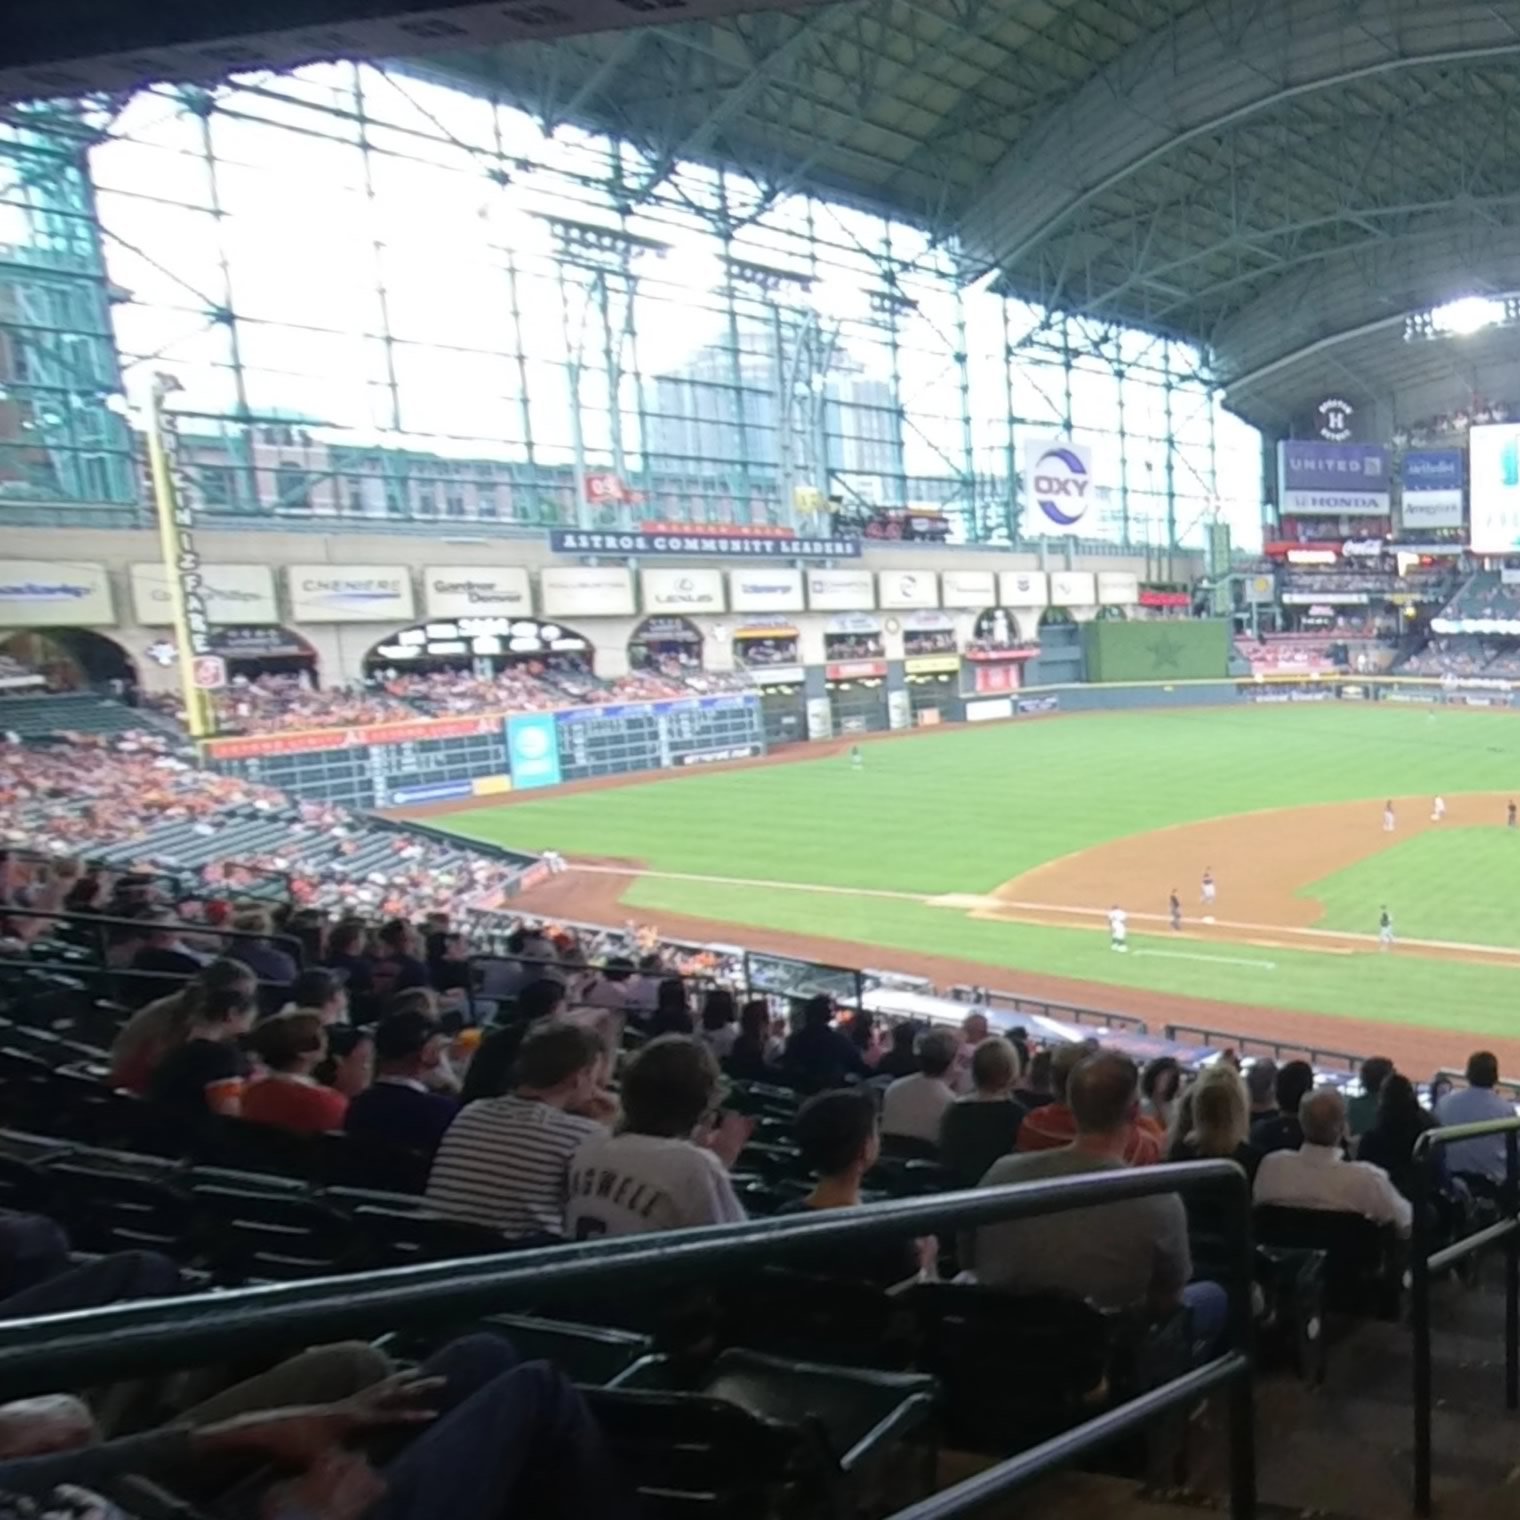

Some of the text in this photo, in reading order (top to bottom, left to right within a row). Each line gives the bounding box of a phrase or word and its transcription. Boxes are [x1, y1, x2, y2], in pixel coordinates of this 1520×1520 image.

[1329, 412, 1344, 430] H
[1289, 457, 1360, 472] UNITED
[1034, 476, 1088, 497] OXY
[1311, 496, 1379, 508] HONDA
[563, 534, 854, 554] ASTROS COMMUNITY LEADERS
[303, 580, 400, 592] CHENIERE
[433, 580, 496, 592] Gardner
[469, 593, 522, 603] Denver
[655, 594, 713, 603] LEXUS
